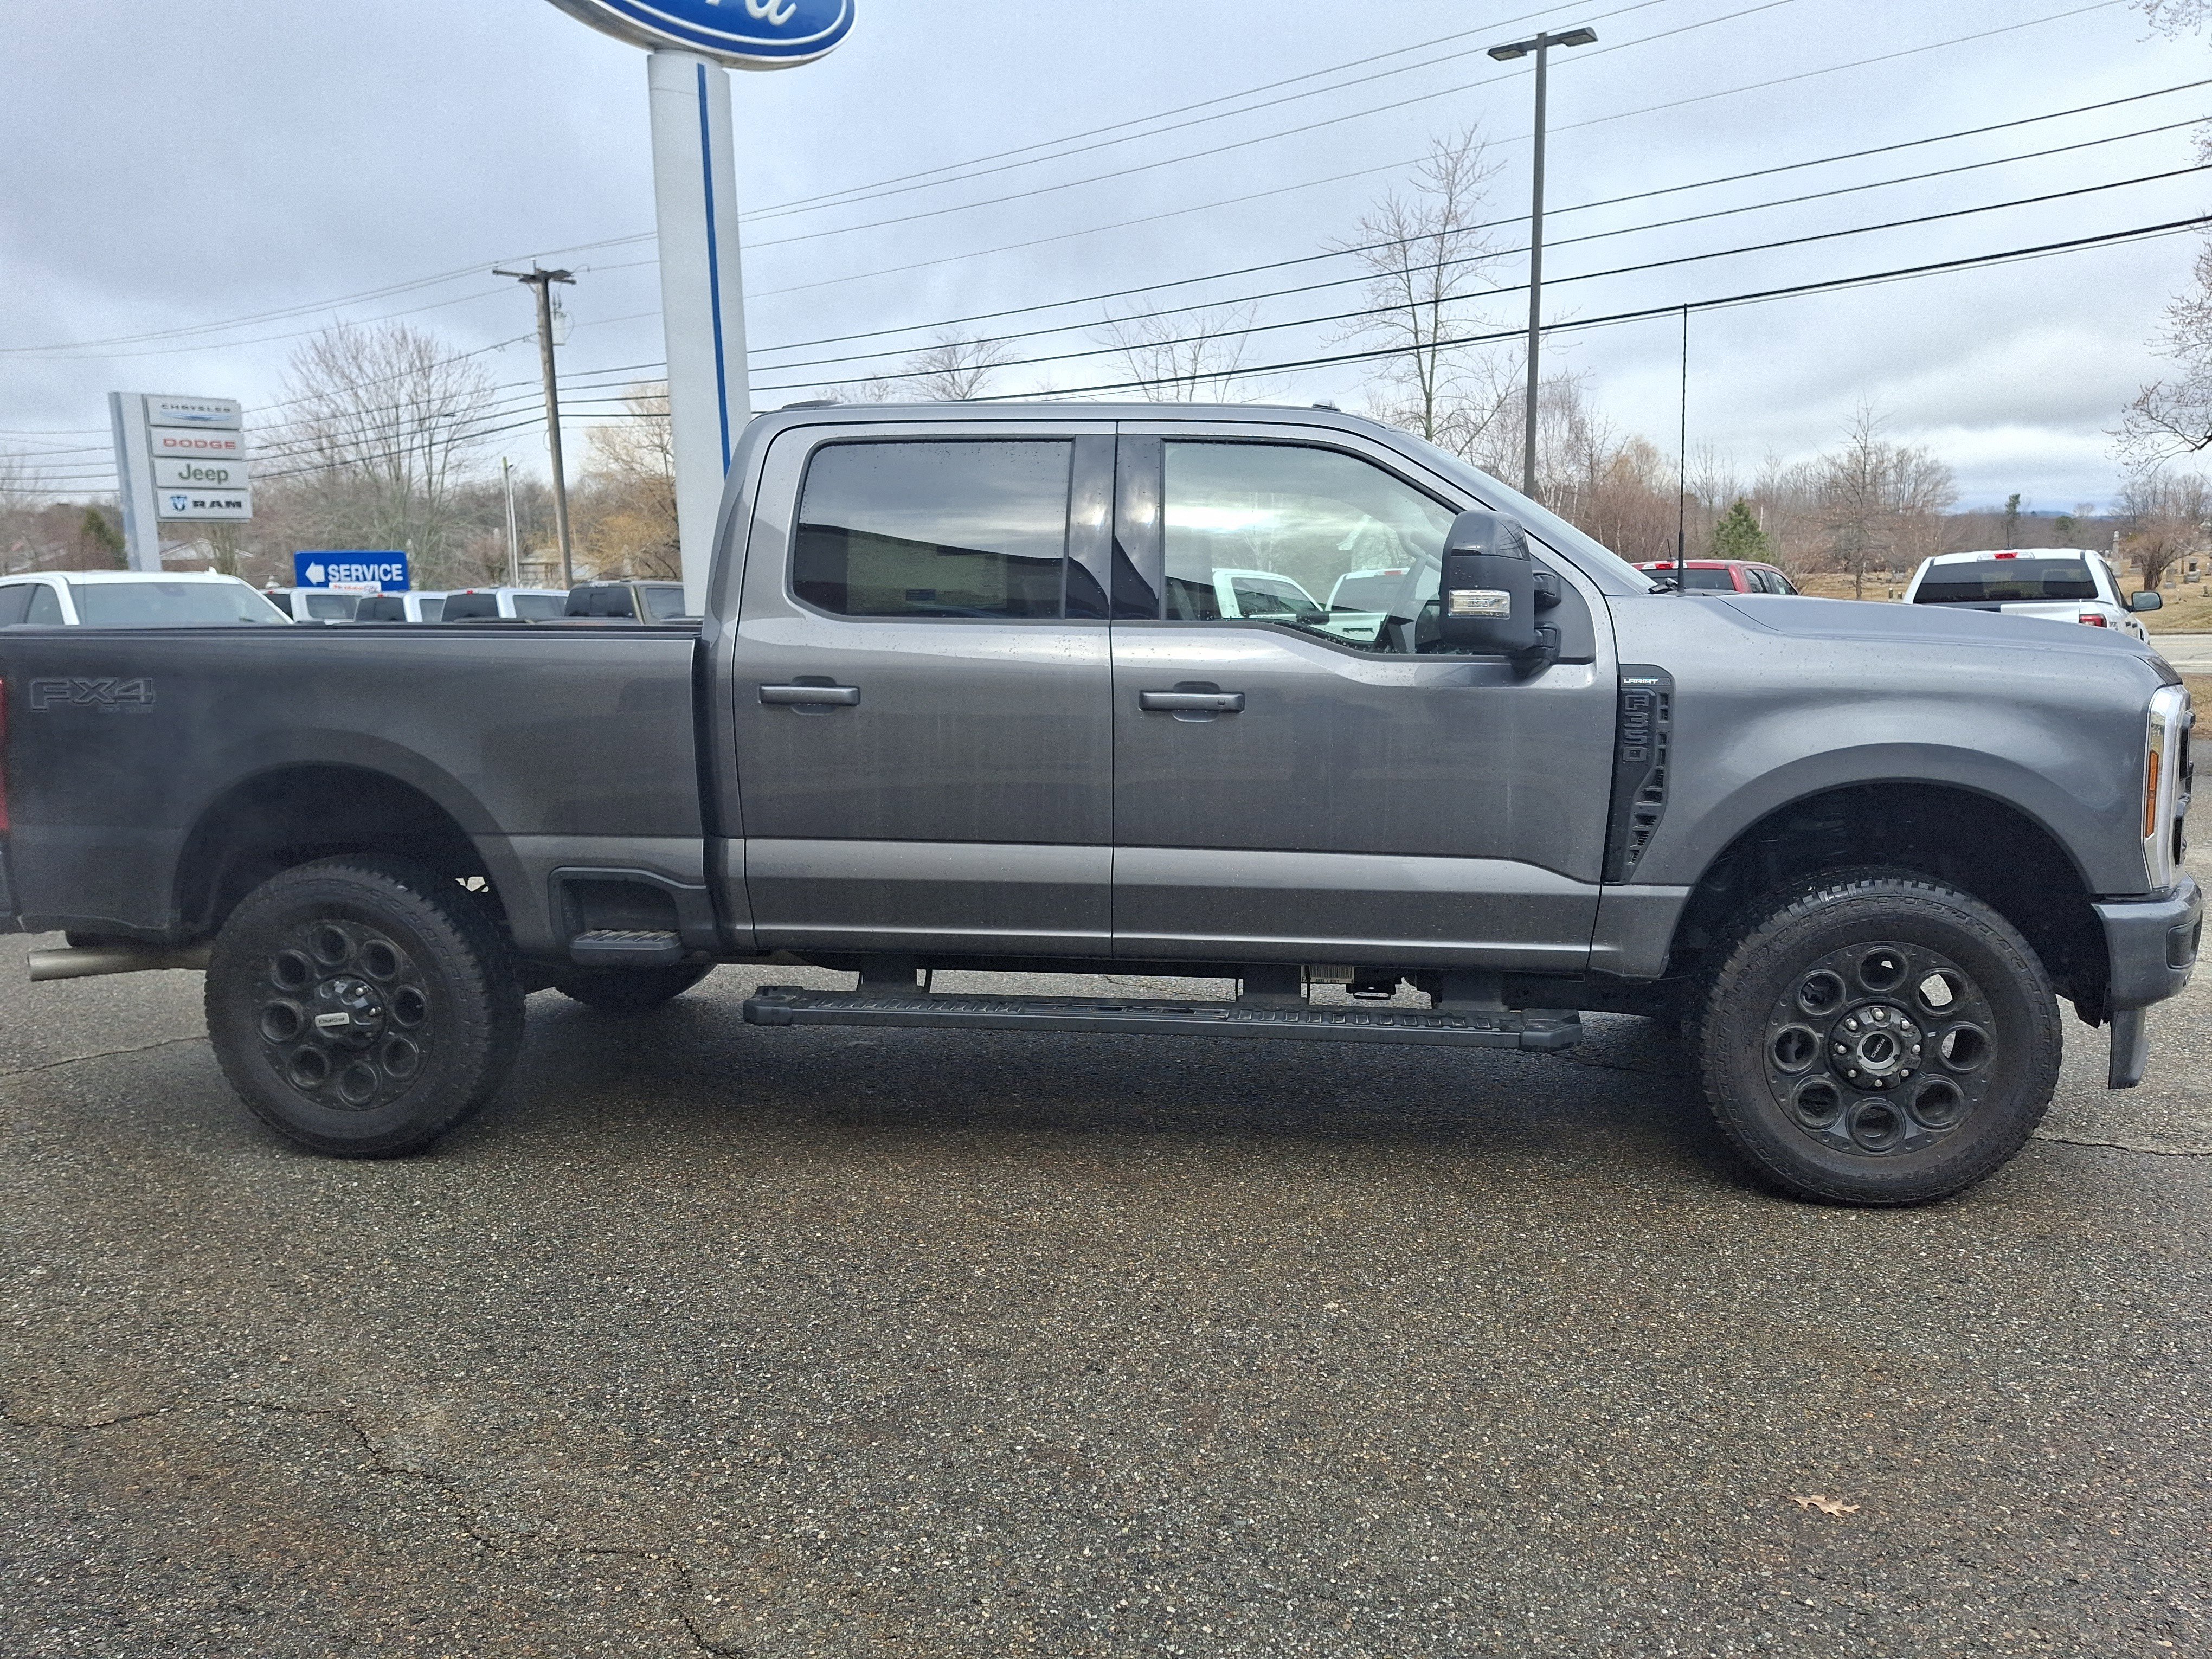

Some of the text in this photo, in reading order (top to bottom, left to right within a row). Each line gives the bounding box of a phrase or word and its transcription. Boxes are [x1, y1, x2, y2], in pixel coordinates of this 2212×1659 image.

[161, 404, 231, 413] CHRYSLER
[163, 438, 236, 450] DODGE
[178, 464, 229, 484] Jeep
[192, 500, 242, 509] RAM
[327, 563, 404, 582] SERVICE
[30, 678, 153, 712] FX4
[1623, 695, 1649, 762] F350
[1870, 1038, 1885, 1058] FORD
